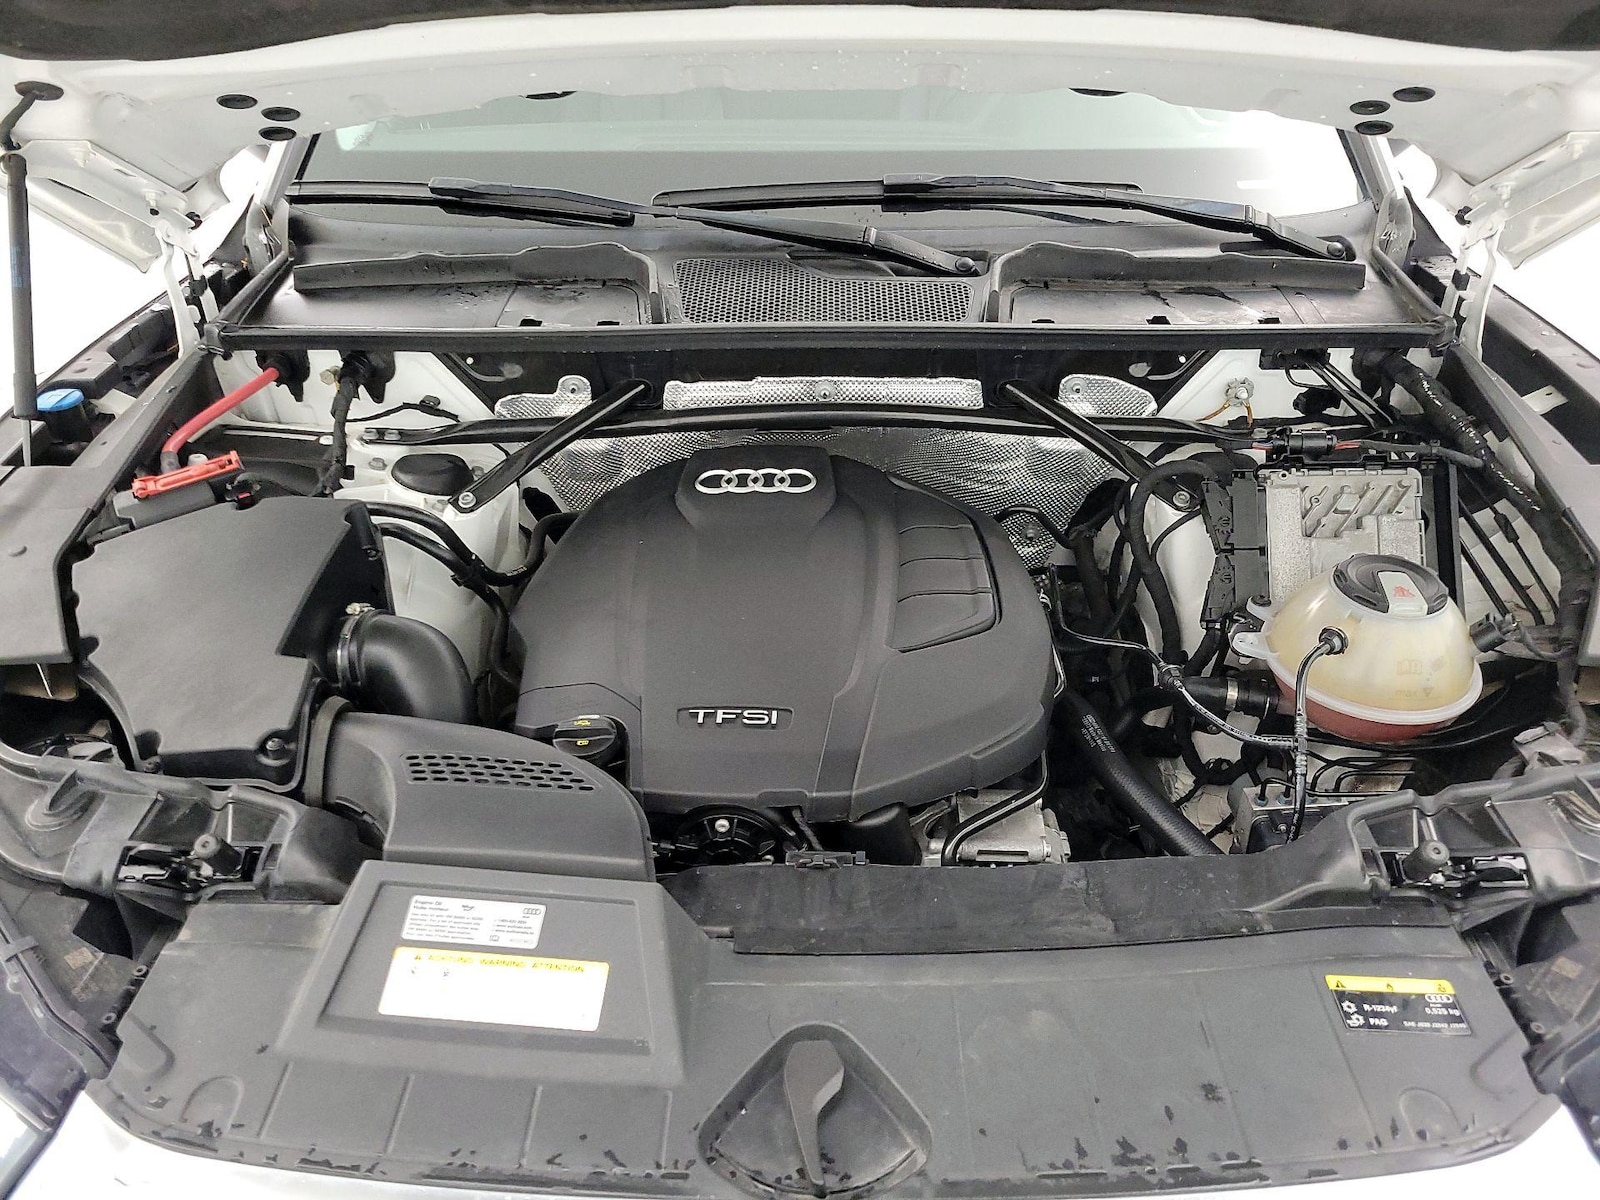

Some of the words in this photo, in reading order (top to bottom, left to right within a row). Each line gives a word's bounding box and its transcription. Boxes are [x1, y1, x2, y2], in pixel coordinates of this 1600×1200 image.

[688, 709, 778, 725] TFSI
[1448, 1008, 1461, 1017] kg
[1368, 1017, 1389, 1027] PAG
